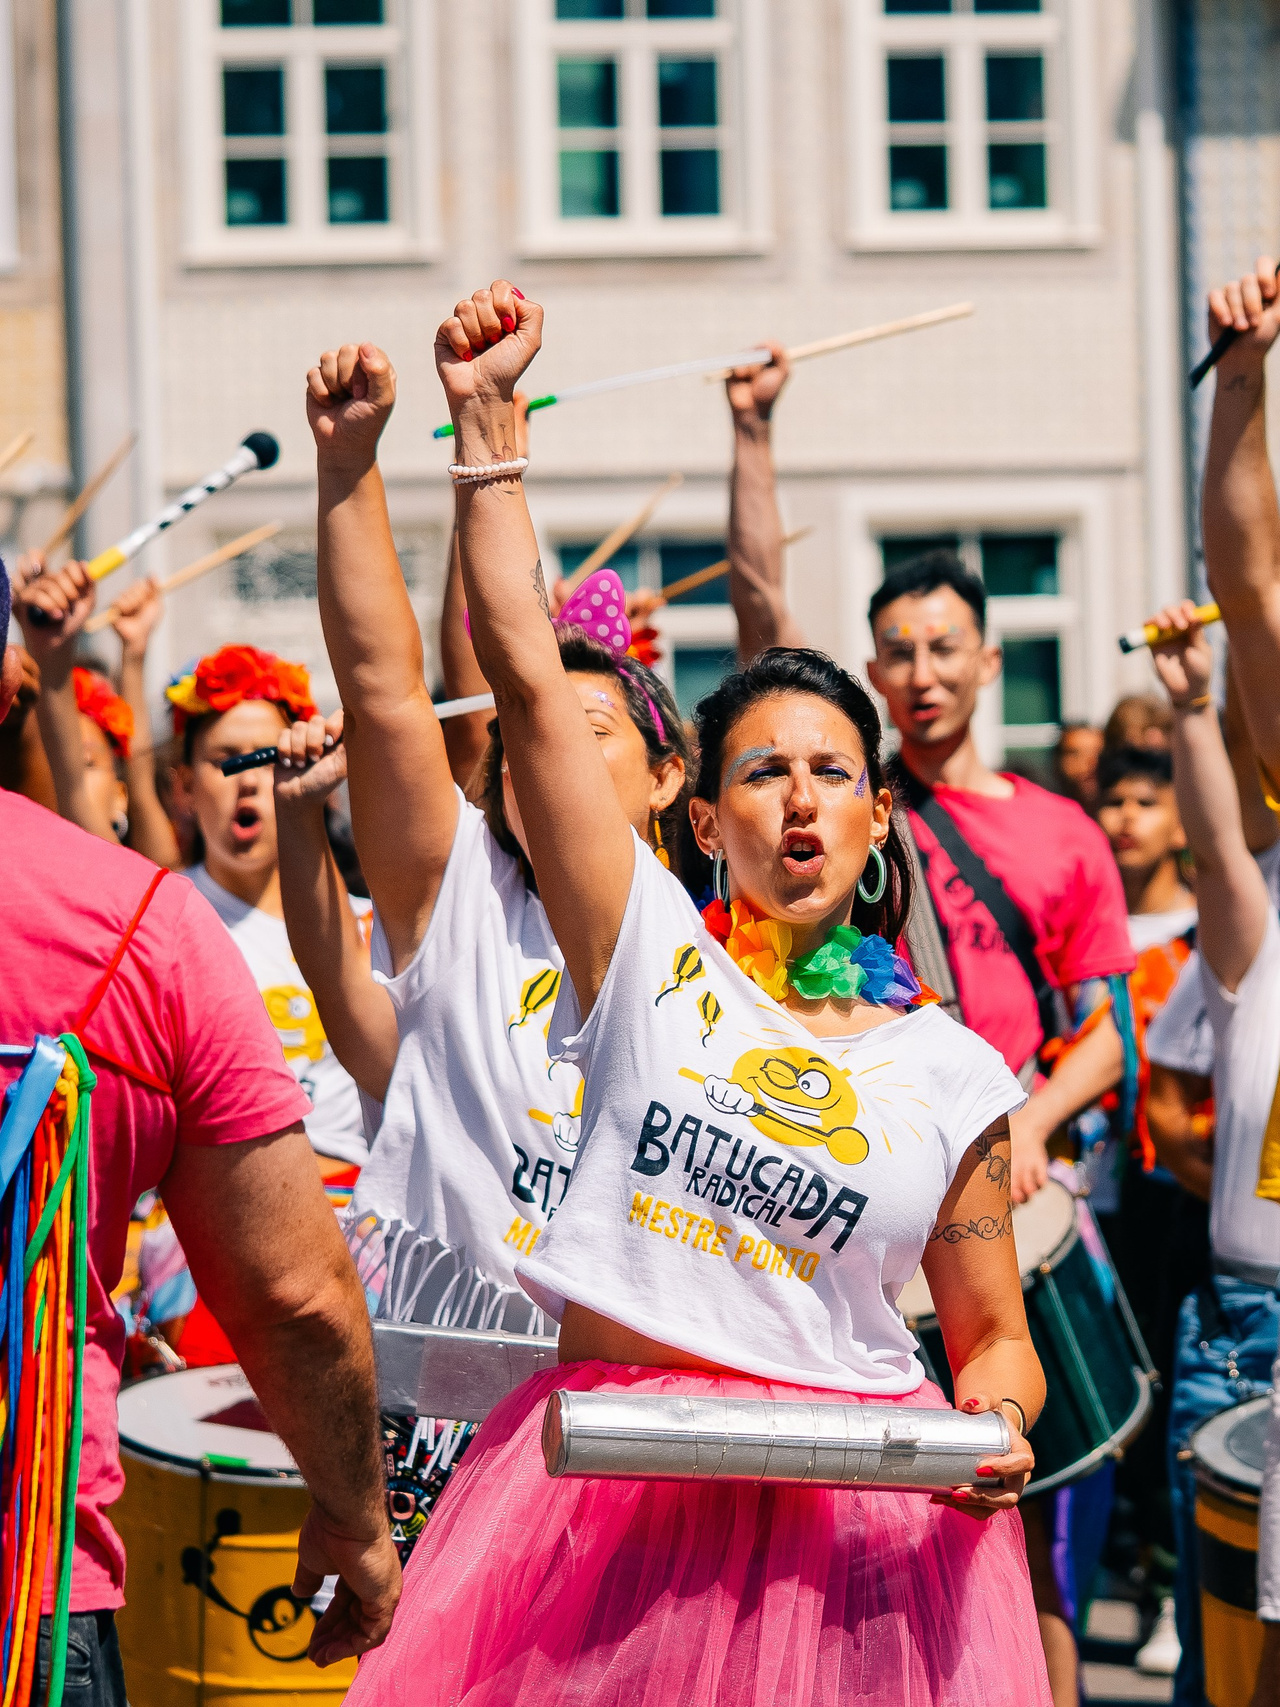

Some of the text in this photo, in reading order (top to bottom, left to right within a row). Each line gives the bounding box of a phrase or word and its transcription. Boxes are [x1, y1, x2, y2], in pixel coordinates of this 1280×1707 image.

[629, 1191, 821, 1283] MESTRE PORTO
[630, 1100, 870, 1254] BATUCADA
